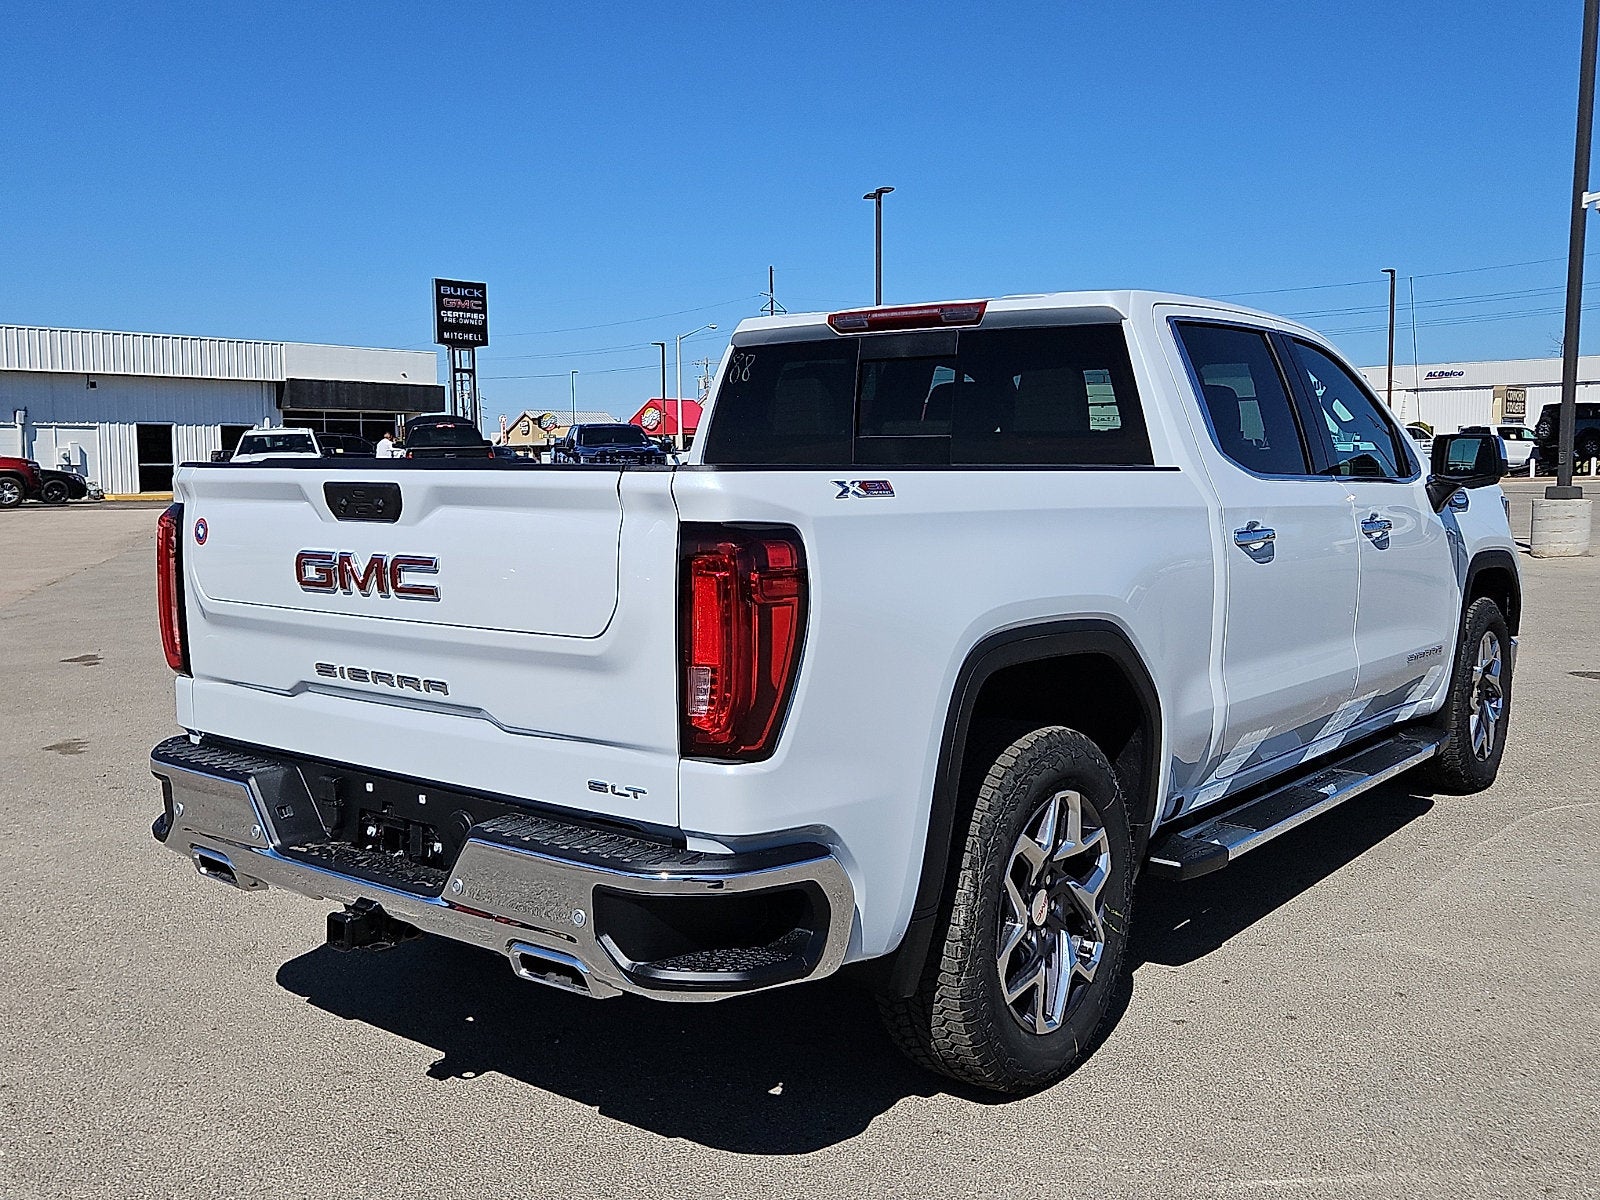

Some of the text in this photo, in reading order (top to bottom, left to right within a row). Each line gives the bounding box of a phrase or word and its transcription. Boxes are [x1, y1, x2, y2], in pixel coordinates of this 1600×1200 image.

[440, 285, 484, 298] BUICK
[443, 297, 483, 310] GMC
[440, 310, 485, 320] CERTIFIED
[443, 316, 483, 326] PRE-OWNED
[443, 331, 483, 341] MITCHELL
[1425, 369, 1465, 378] ACDelco
[295, 549, 441, 602] GMC
[314, 661, 450, 697] SIERRA
[587, 779, 648, 800] SLT
